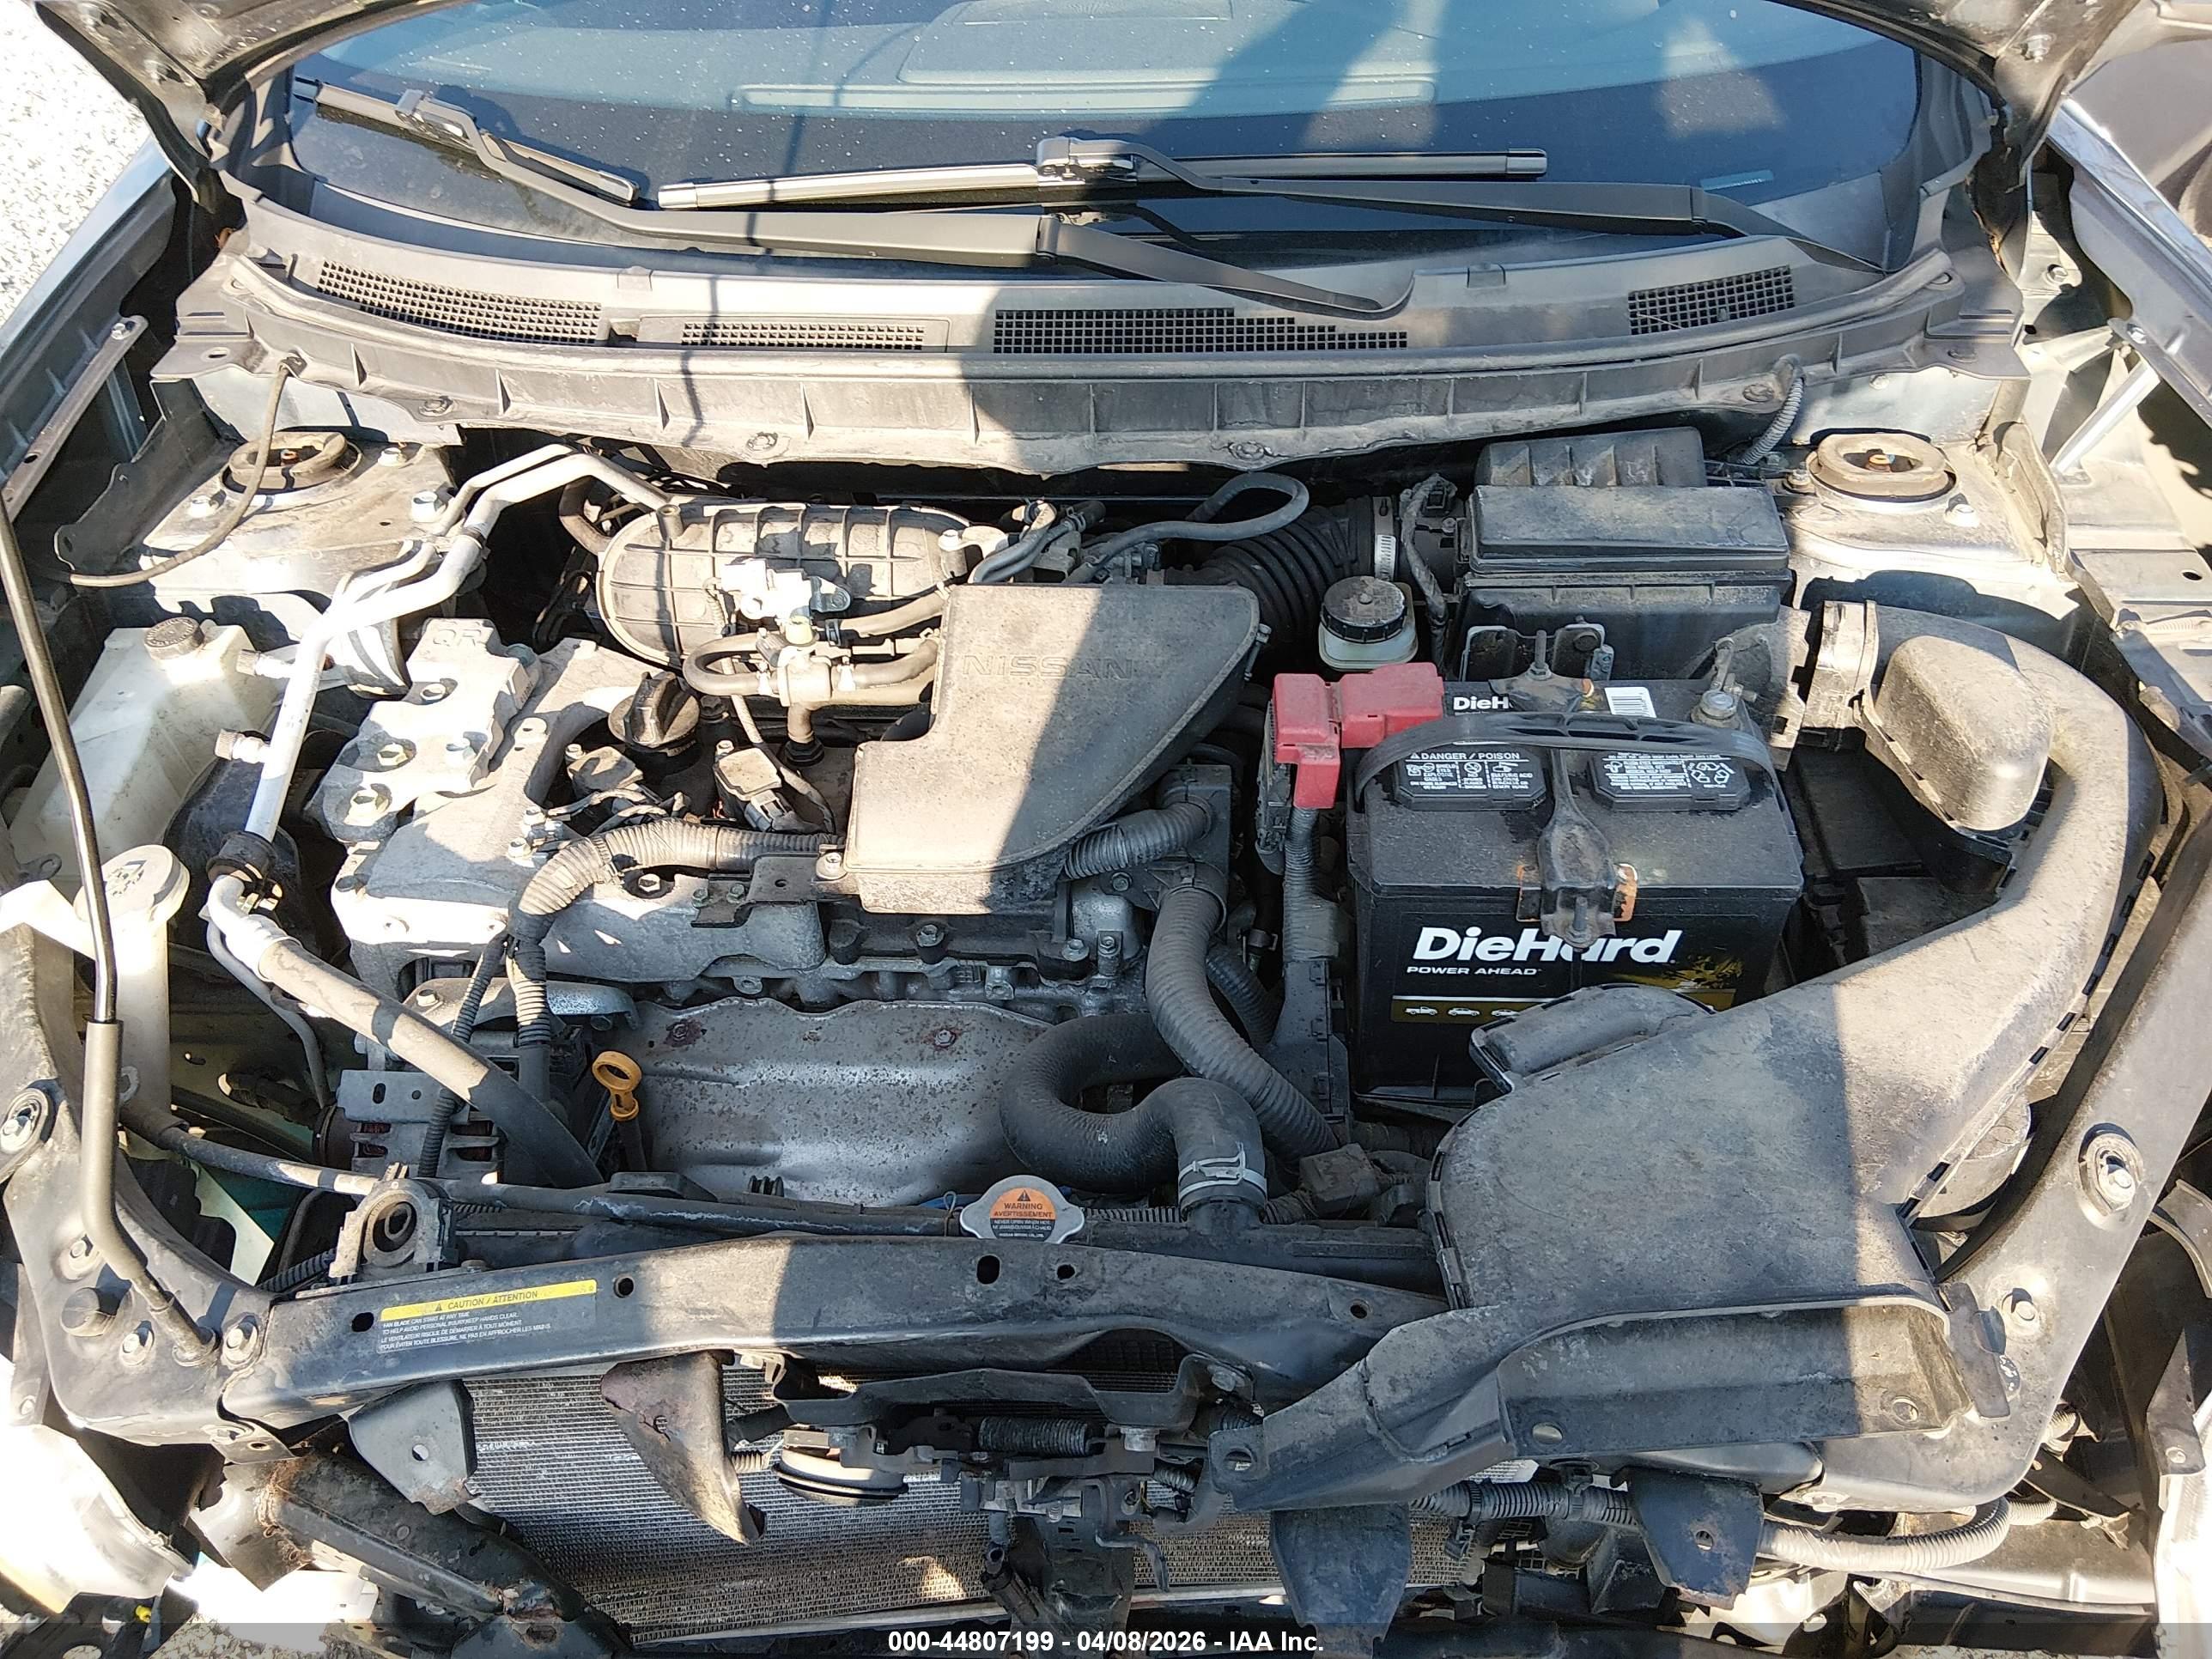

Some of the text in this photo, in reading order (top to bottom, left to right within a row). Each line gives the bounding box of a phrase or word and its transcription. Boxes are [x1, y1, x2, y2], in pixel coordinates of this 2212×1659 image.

[963, 654, 1134, 679] NISSAN
[1453, 696, 1514, 710] DieH
[1474, 967, 1538, 975] AHEAD
[447, 1297, 484, 1310] CAUTION
[493, 1291, 538, 1304] ATTENTION
